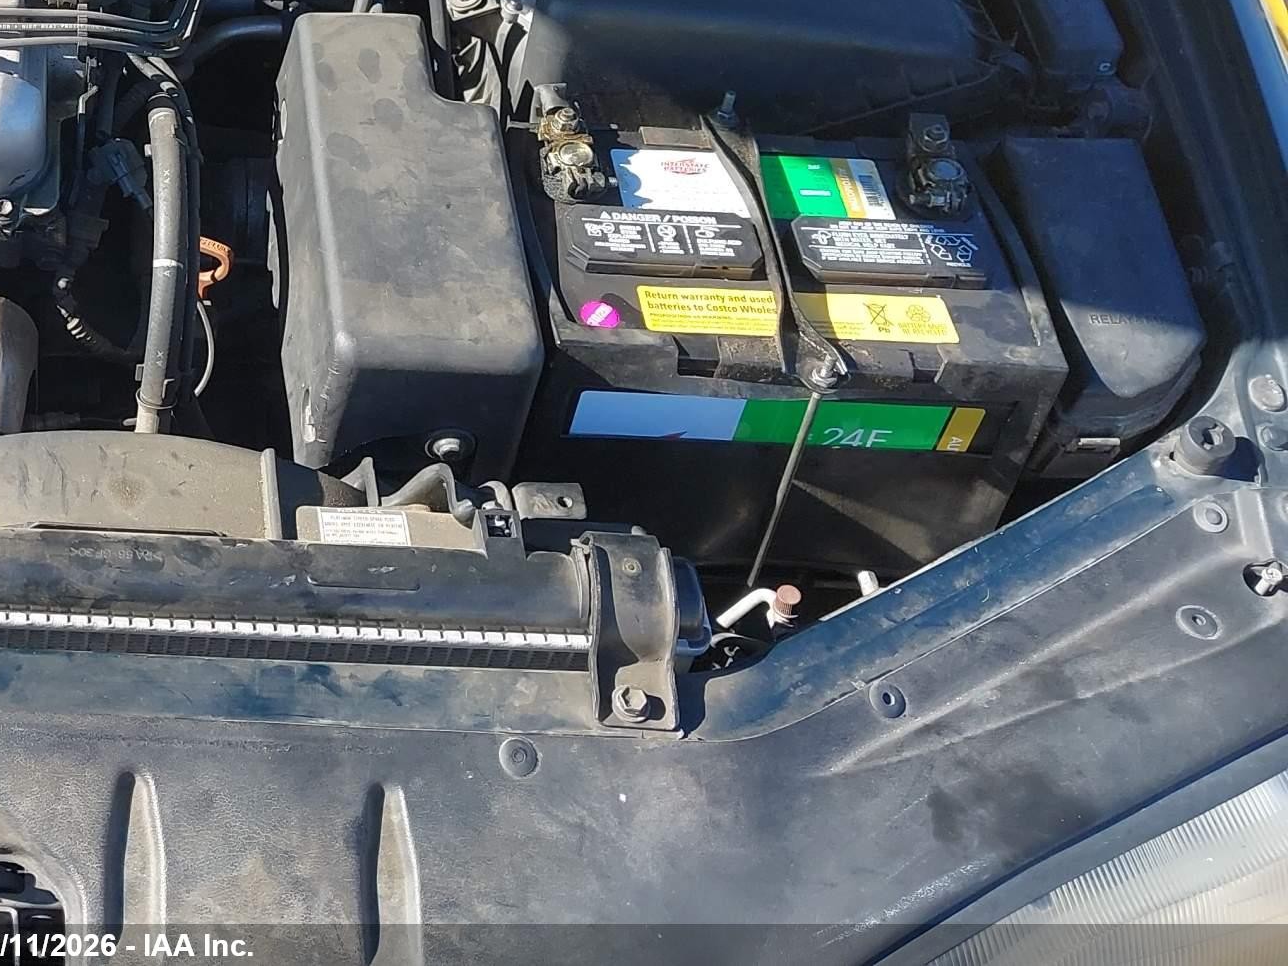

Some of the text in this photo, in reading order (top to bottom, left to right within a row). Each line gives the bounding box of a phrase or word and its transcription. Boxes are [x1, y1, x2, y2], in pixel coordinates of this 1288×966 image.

[612, 211, 662, 223] DANGER
[671, 215, 717, 225] POISON
[644, 290, 774, 304] Return warranty and used
[647, 301, 691, 312] batteries
[693, 303, 704, 312] to
[705, 303, 738, 313] Costco
[877, 326, 891, 334] Pb
[822, 427, 893, 449] 24F
